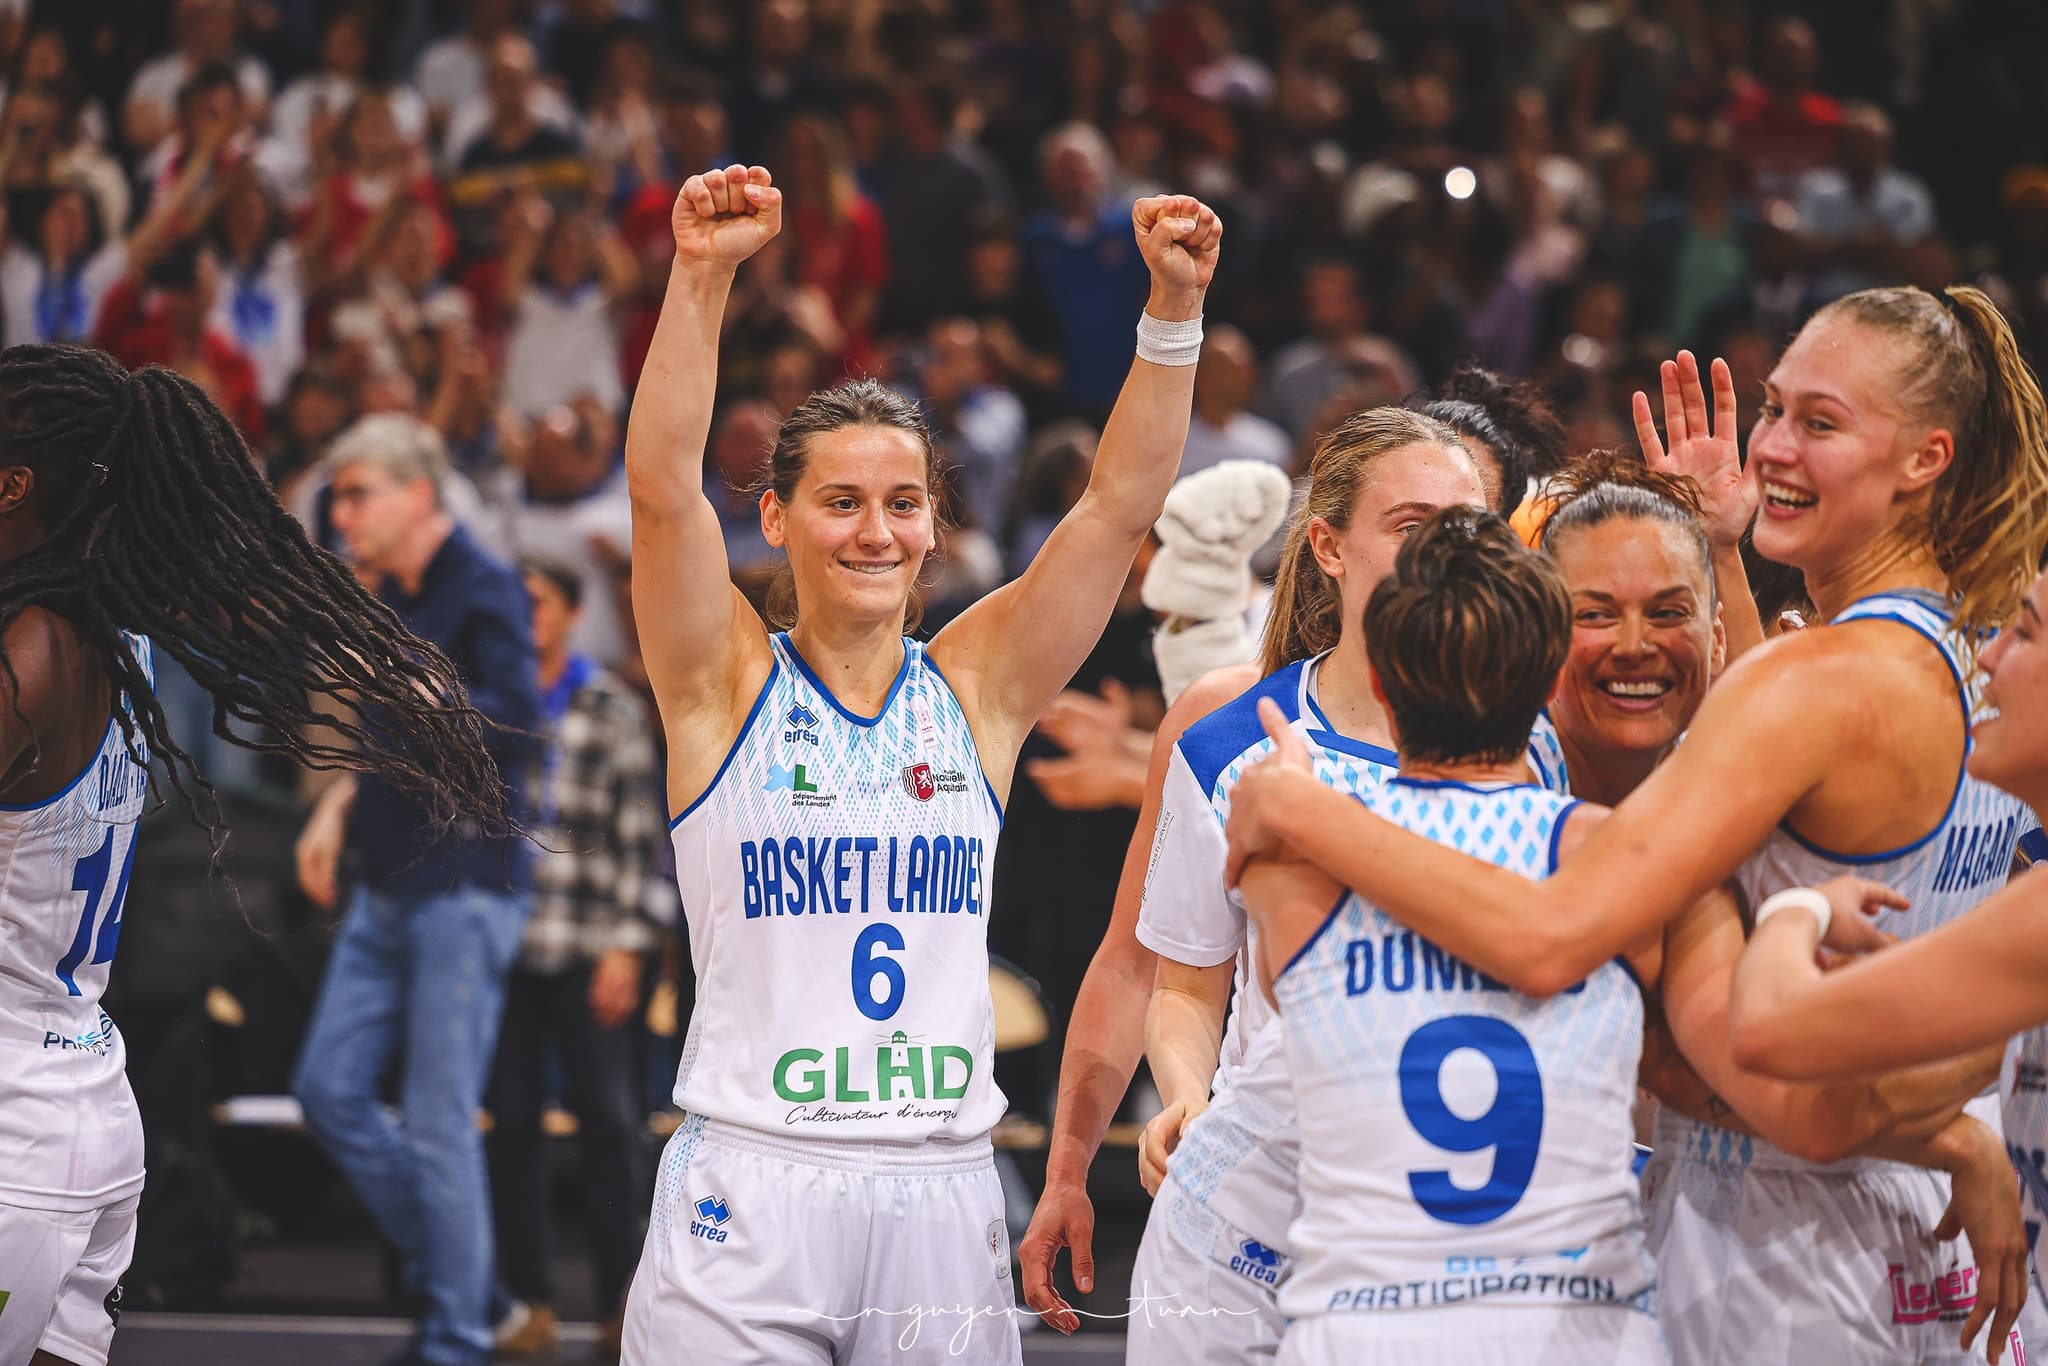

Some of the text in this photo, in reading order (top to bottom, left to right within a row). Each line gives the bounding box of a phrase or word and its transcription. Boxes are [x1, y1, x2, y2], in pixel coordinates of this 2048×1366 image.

[740, 834, 983, 919] BASKET LANDES
[851, 922, 906, 1021] 6
[1346, 929, 1589, 998] DUM
[785, 1106, 889, 1125] Cultivateur
[1398, 1015, 1544, 1225] 9
[1328, 1273, 1614, 1312] PARTICIPATION
